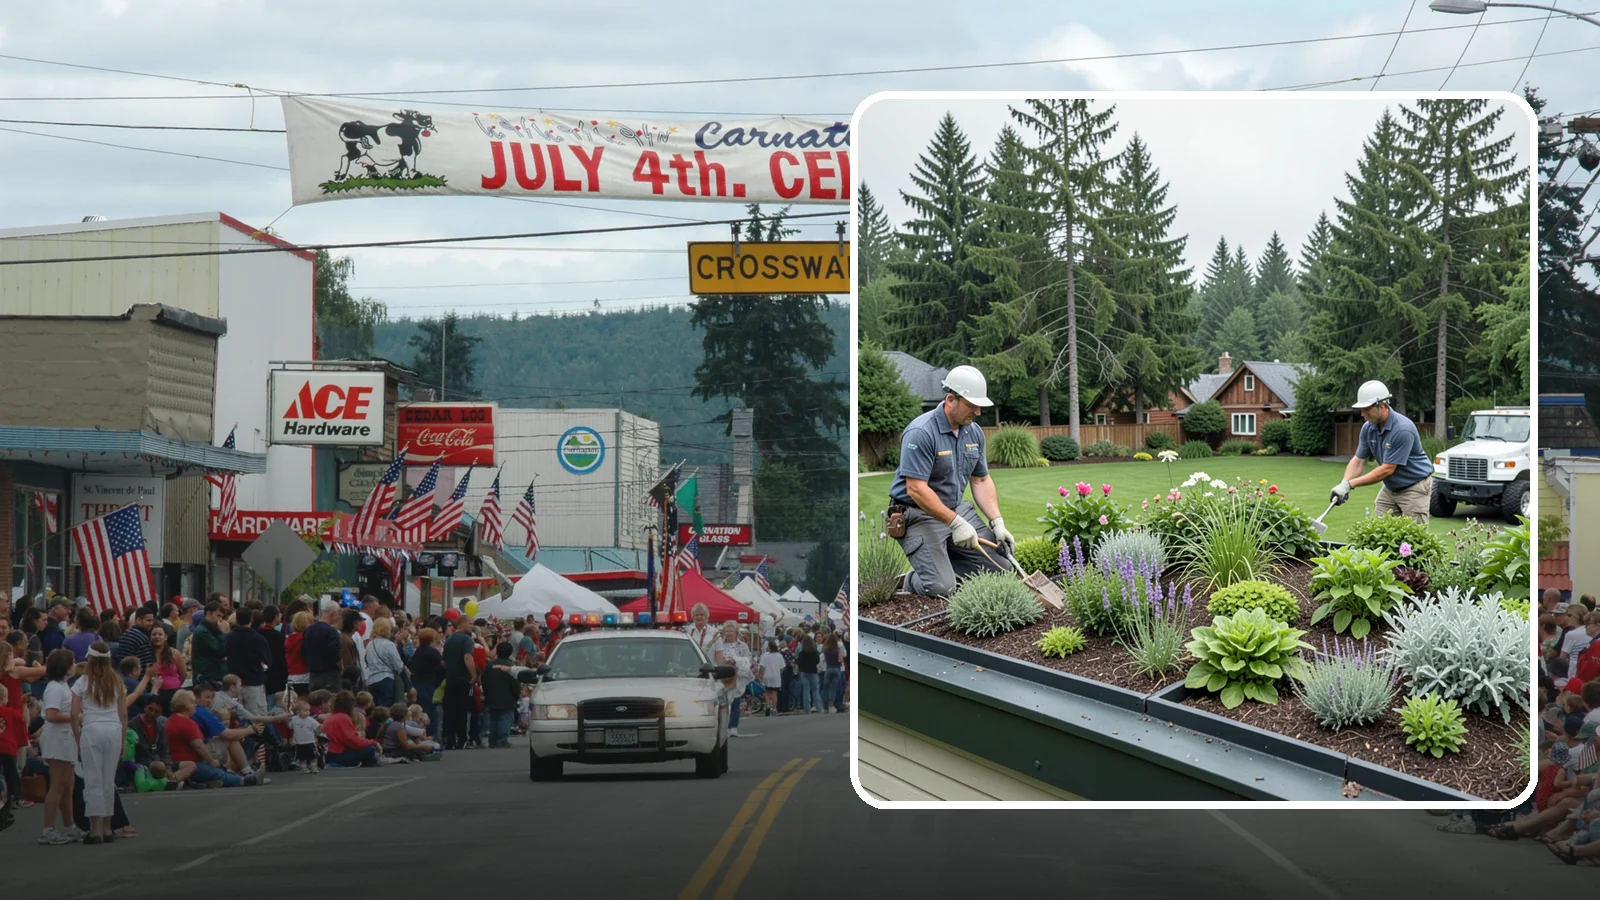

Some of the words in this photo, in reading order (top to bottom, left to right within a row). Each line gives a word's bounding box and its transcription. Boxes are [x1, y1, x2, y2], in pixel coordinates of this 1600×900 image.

[481, 141, 605, 193] JULY
[632, 150, 746, 198] 4th.
[696, 253, 850, 280] CROSSWA
[282, 380, 374, 420] ACE
[405, 408, 453, 422] CEDAR
[461, 408, 485, 421] LOG
[283, 421, 371, 437] Hardware
[416, 428, 477, 446] Coca-Cola
[353, 466, 385, 480] Simpl
[83, 484, 94, 494] St.
[95, 485, 124, 495] Vincent
[126, 486, 136, 495] de
[137, 485, 155, 495] Paul
[687, 526, 742, 536] CRNATION
[698, 535, 731, 544] GLASS
